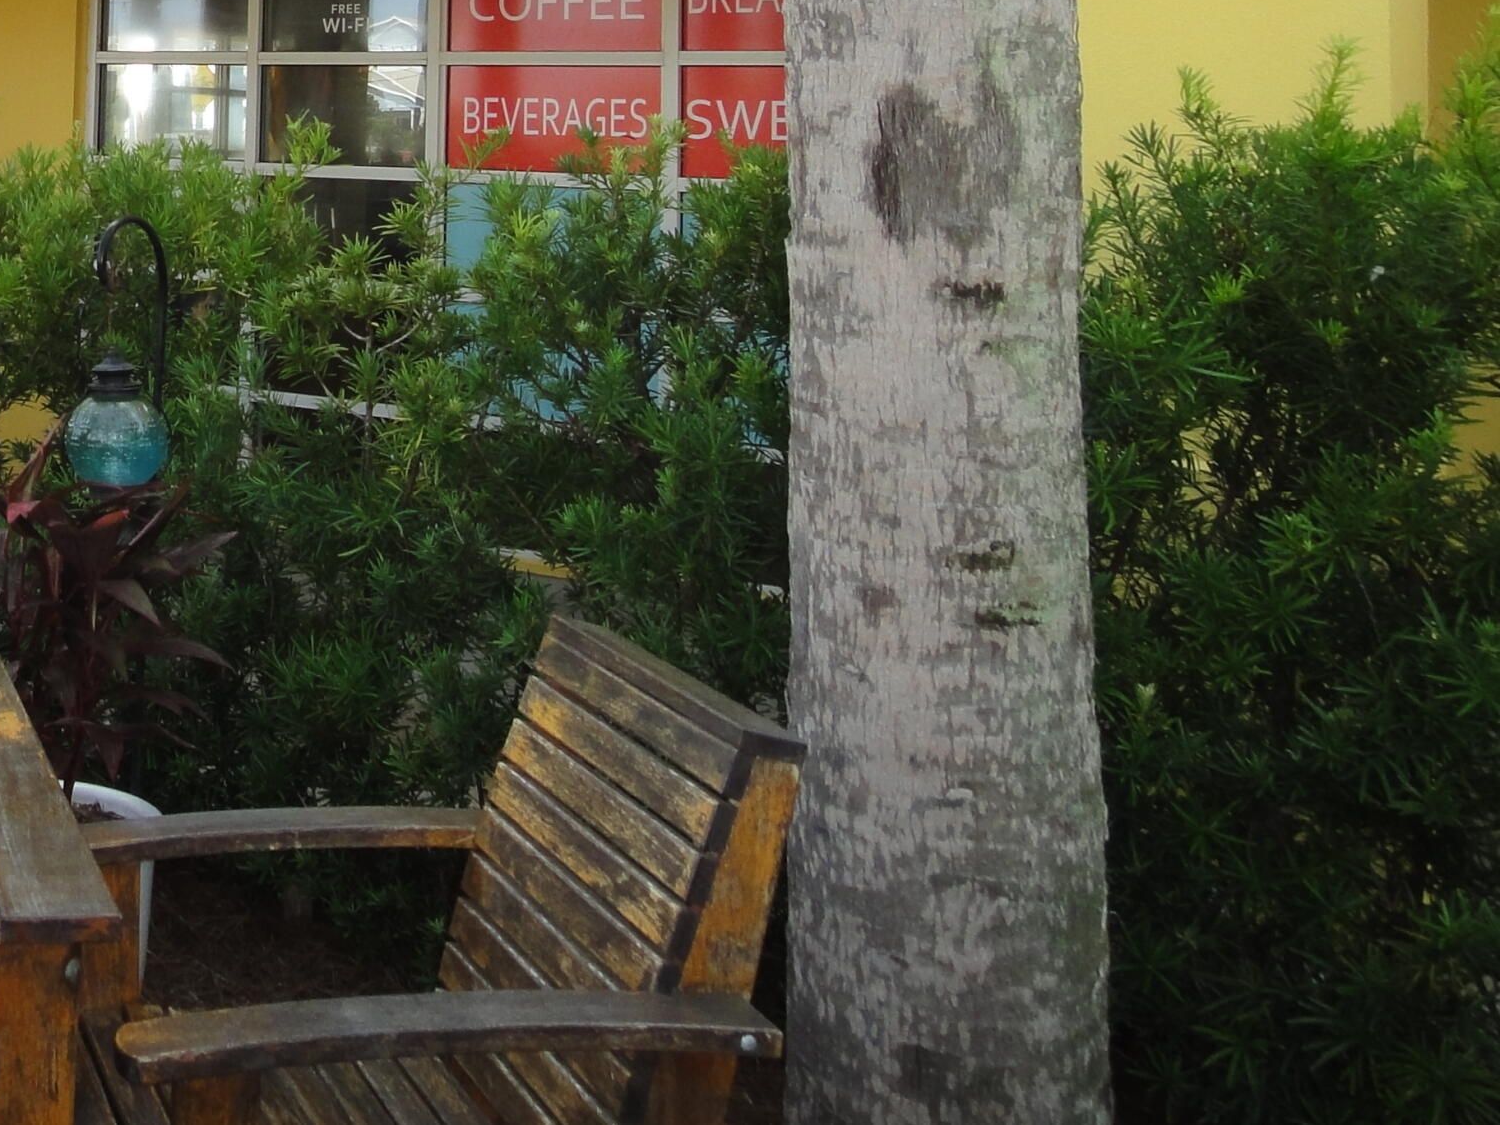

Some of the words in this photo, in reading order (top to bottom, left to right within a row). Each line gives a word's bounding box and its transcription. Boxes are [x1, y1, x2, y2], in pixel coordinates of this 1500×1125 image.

[331, 4, 361, 14] FREE
[463, 97, 648, 138] BEVERAGES
[686, 99, 788, 141] SWE
